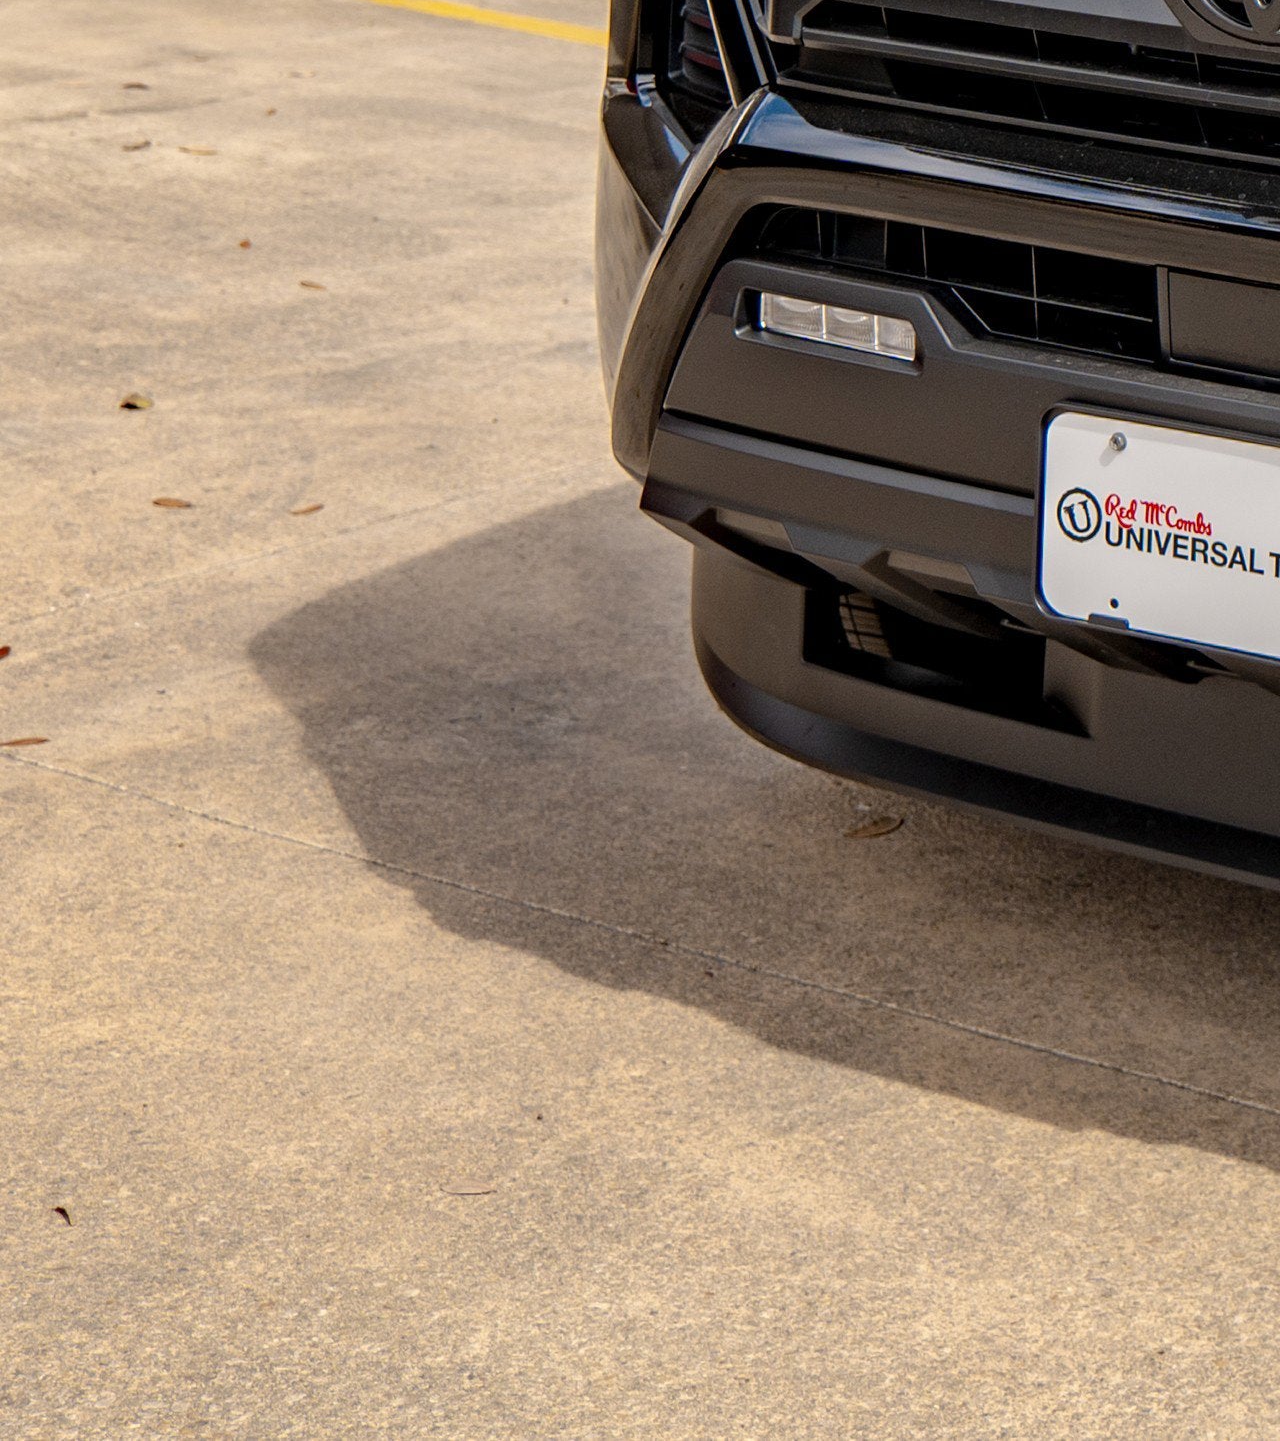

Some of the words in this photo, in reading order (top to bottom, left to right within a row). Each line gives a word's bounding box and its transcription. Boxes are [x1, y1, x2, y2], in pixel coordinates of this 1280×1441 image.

[1105, 493, 1137, 529] Red
[1140, 500, 1212, 536] McCombs
[1105, 521, 1264, 575] UNIVERSAL
